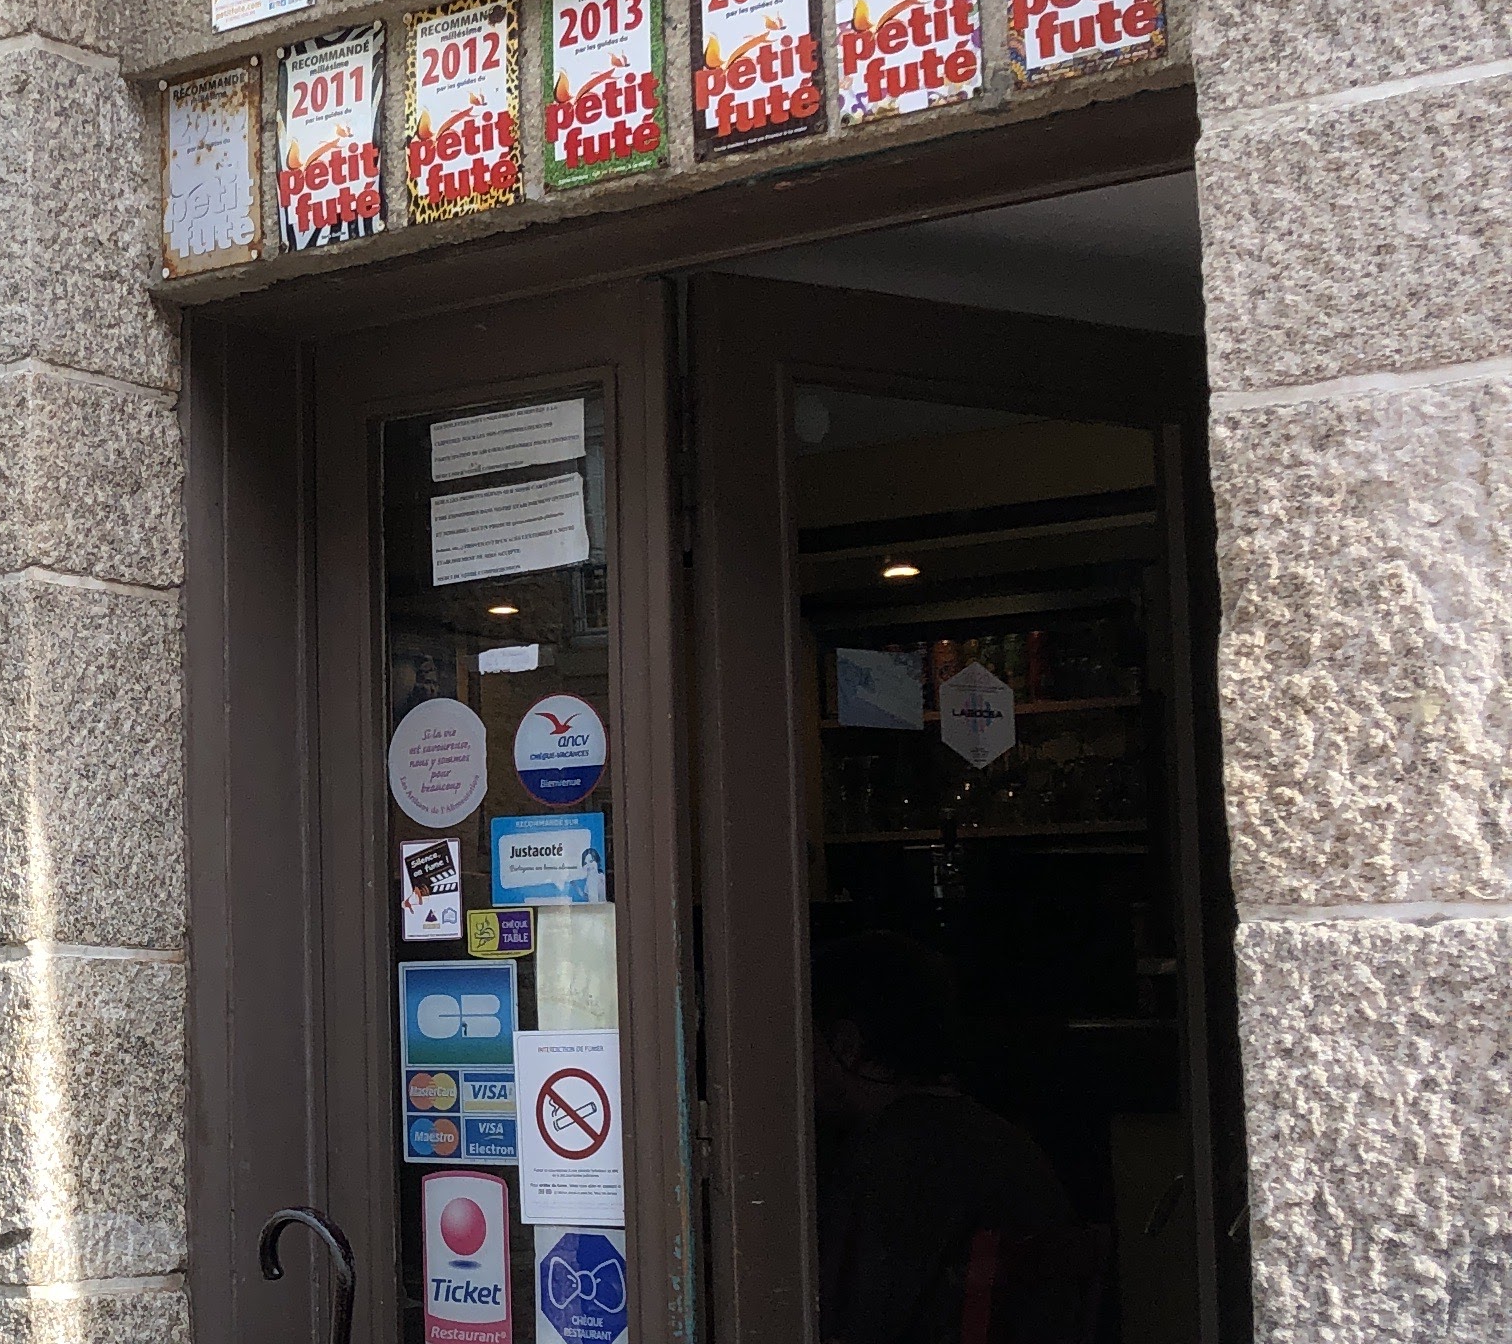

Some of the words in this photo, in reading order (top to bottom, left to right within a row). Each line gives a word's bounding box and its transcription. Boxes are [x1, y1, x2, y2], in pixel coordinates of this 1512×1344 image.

[420, 1, 500, 38] RECOMMAN
[440, 26, 482, 43] millésime
[291, 39, 370, 72] RECOMMANDÉ
[309, 59, 349, 76] millésime
[421, 31, 500, 87] 2012
[696, 34, 817, 111] petit
[864, 41, 977, 102] futé
[291, 65, 364, 119] 2011
[544, 72, 660, 143] petit
[716, 78, 821, 136] futé
[409, 110, 516, 179] petit
[564, 114, 661, 169] futé
[279, 142, 380, 208] petit
[425, 152, 518, 203] futé
[295, 180, 381, 234] futé
[558, 734, 590, 748] ancv
[509, 843, 564, 859] Justacoté
[502, 932, 529, 943] TABLE
[409, 1085, 456, 1097] MasterCard
[470, 1083, 508, 1100] VISA
[414, 1131, 454, 1143] Maestro
[478, 1122, 504, 1134] VISA
[469, 1143, 515, 1155] Electron
[431, 1278, 502, 1306] Ticket
